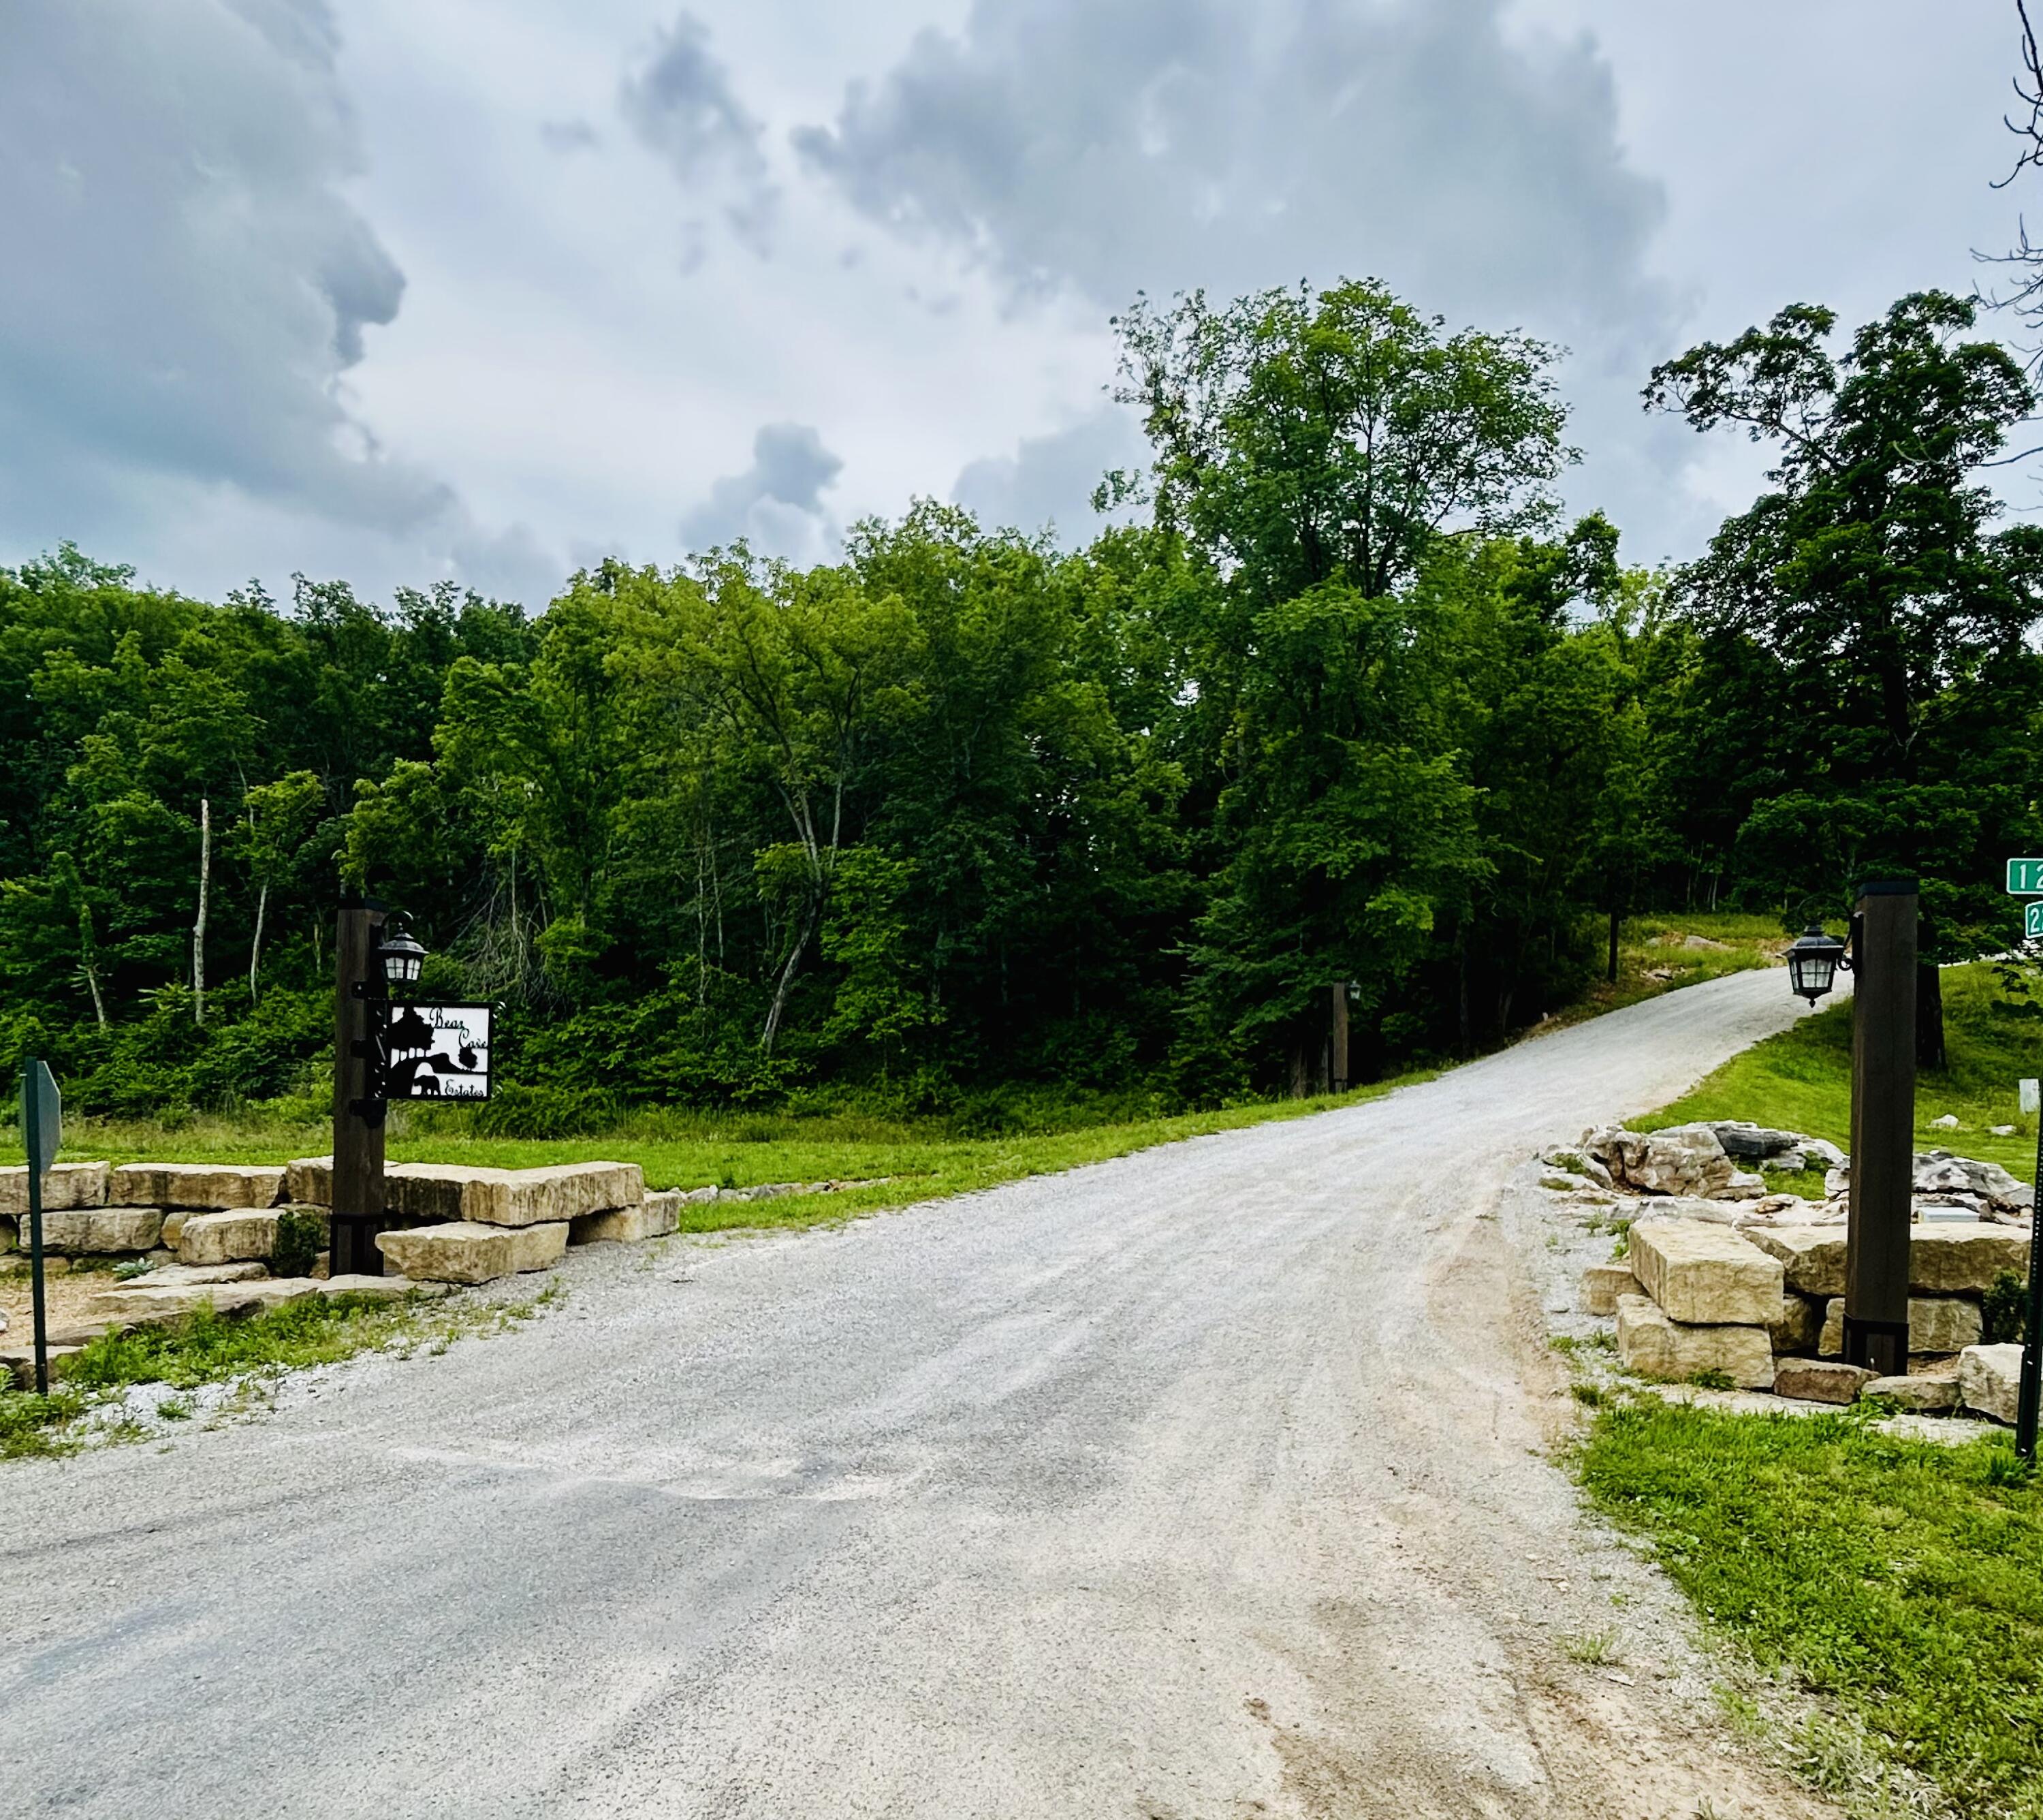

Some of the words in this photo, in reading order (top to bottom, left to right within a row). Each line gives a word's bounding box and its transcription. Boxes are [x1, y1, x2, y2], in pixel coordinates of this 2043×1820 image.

[2029, 907, 2043, 933] 2
[430, 1007, 464, 1029] Bear
[459, 1028, 486, 1048] Cave
[445, 1079, 484, 1097] Estates
